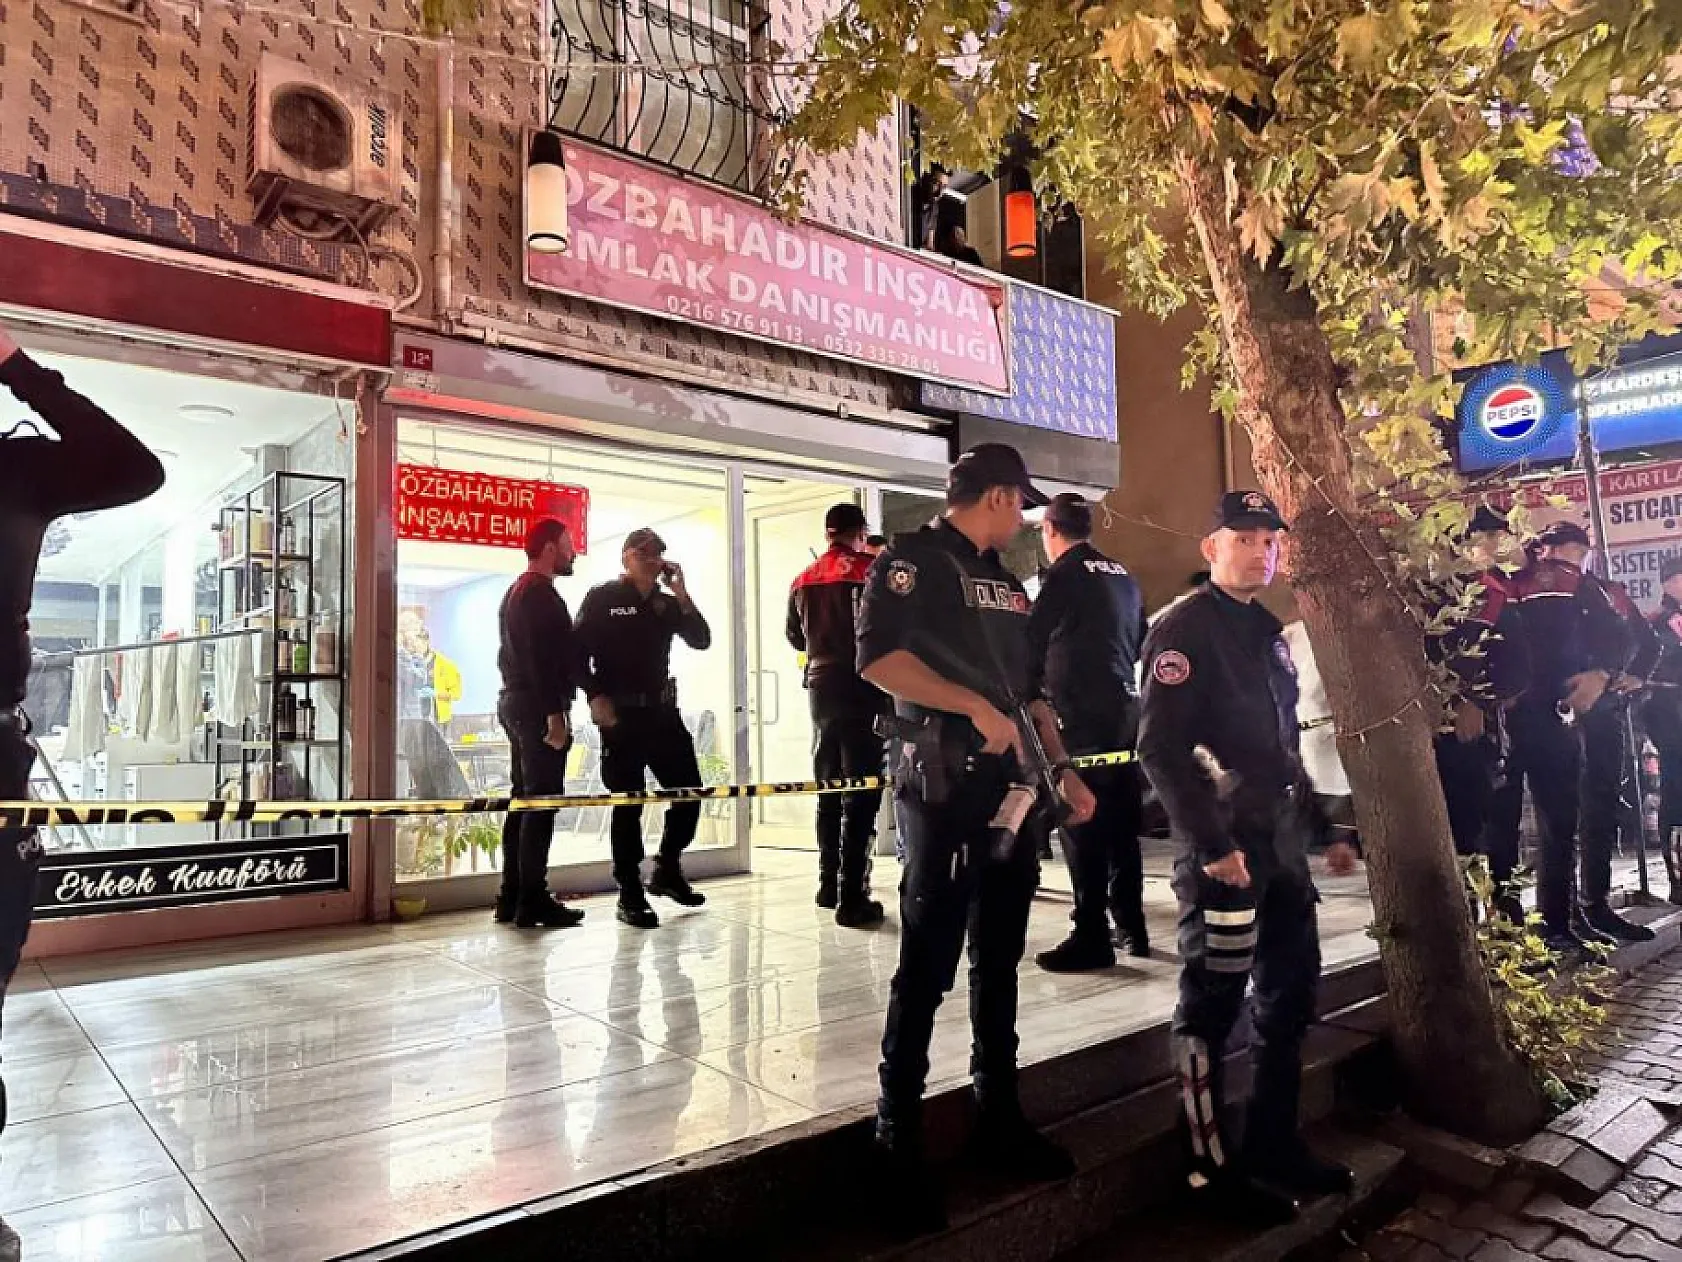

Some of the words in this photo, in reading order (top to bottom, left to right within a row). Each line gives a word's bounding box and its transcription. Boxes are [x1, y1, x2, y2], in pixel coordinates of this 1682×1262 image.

[564, 226, 716, 295] MLAK
[729, 271, 997, 365] DANIŞMANLIĞI
[667, 295, 714, 322] 0216
[721, 308, 755, 332] 576
[759, 319, 780, 338] 91
[786, 325, 803, 344] 13
[1486, 404, 1538, 422] PEPSI
[400, 468, 535, 509] ÖZBAHADIR
[400, 496, 485, 534] İNŞAAT
[55, 869, 156, 901] Erkek
[167, 856, 307, 892] Kuaförü
